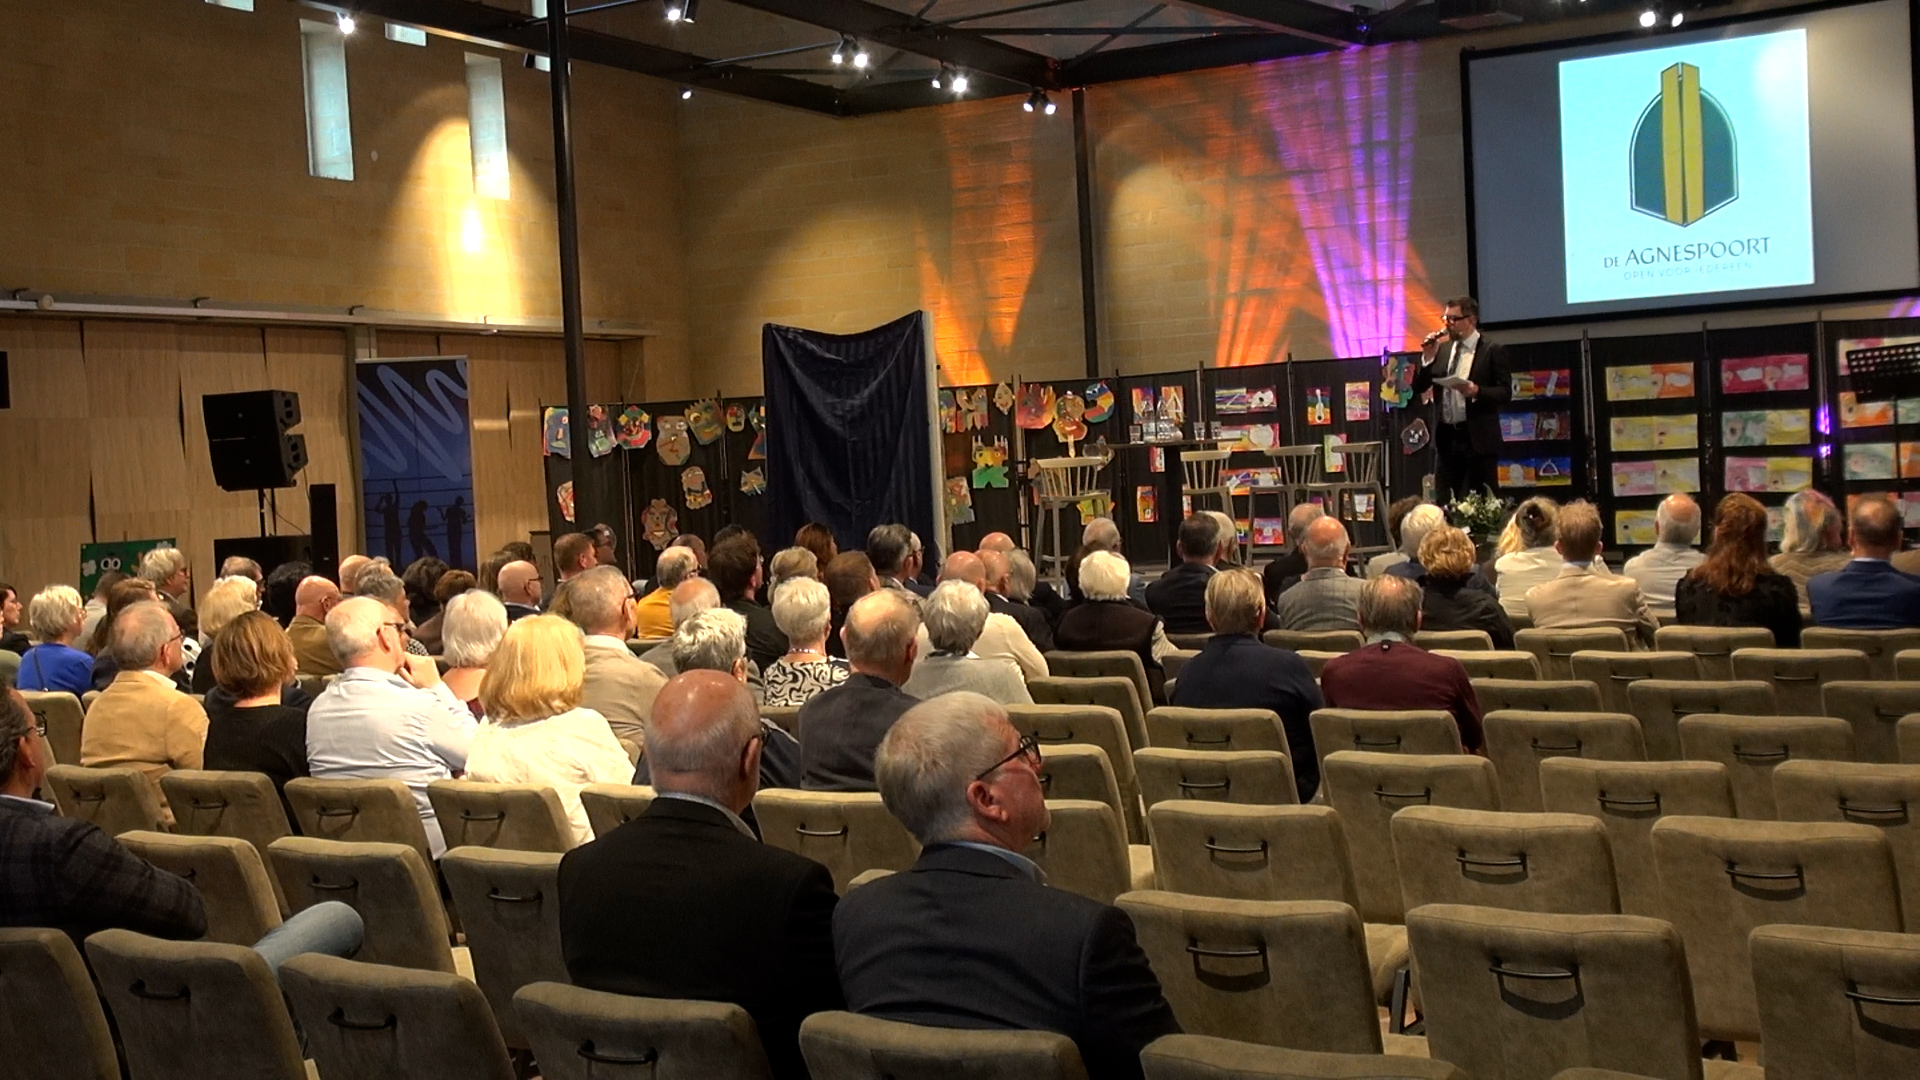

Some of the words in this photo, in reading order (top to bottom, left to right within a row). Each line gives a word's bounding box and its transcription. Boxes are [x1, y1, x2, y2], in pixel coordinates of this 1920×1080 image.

[1604, 256, 1620, 268] DE
[1625, 237, 1771, 266] AGNESPOORT
[1624, 270, 1655, 281] OPEN
[1659, 266, 1691, 278] VOOR
